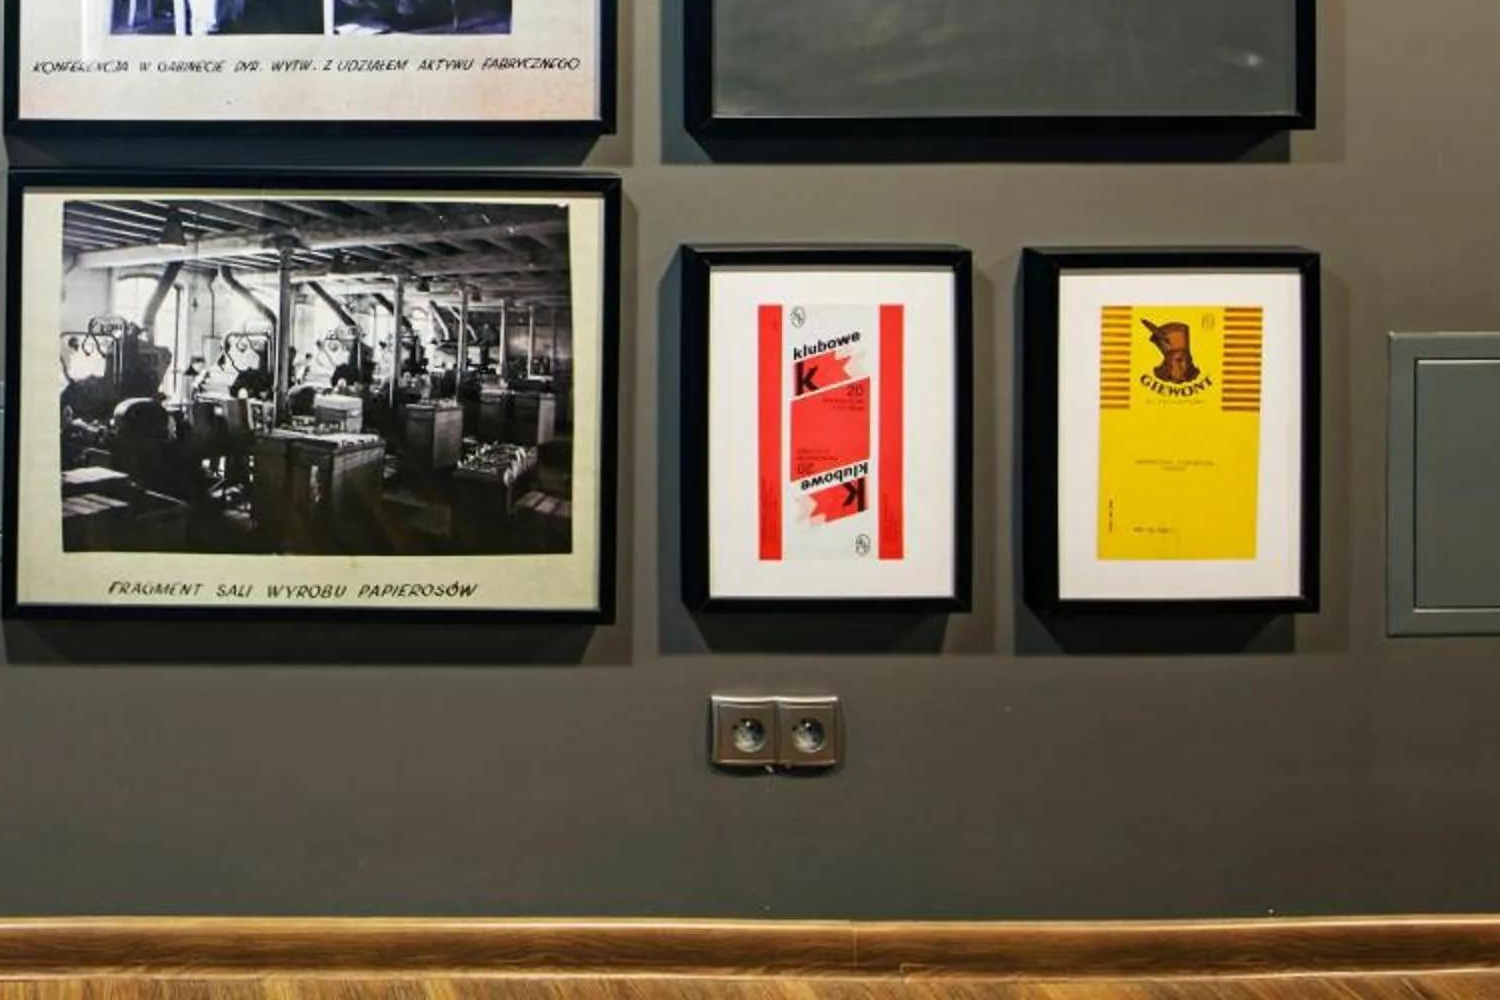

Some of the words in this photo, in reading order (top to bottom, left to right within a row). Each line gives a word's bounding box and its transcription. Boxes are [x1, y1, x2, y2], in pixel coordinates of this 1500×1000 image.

[139, 60, 150, 72] W
[793, 331, 860, 360] klubowe
[801, 461, 868, 491] klubowe
[108, 581, 203, 596] FRAGMENT
[216, 584, 252, 597] SALI
[267, 585, 347, 599] WYROBU
[358, 581, 478, 598] PAPIEROSÓW
